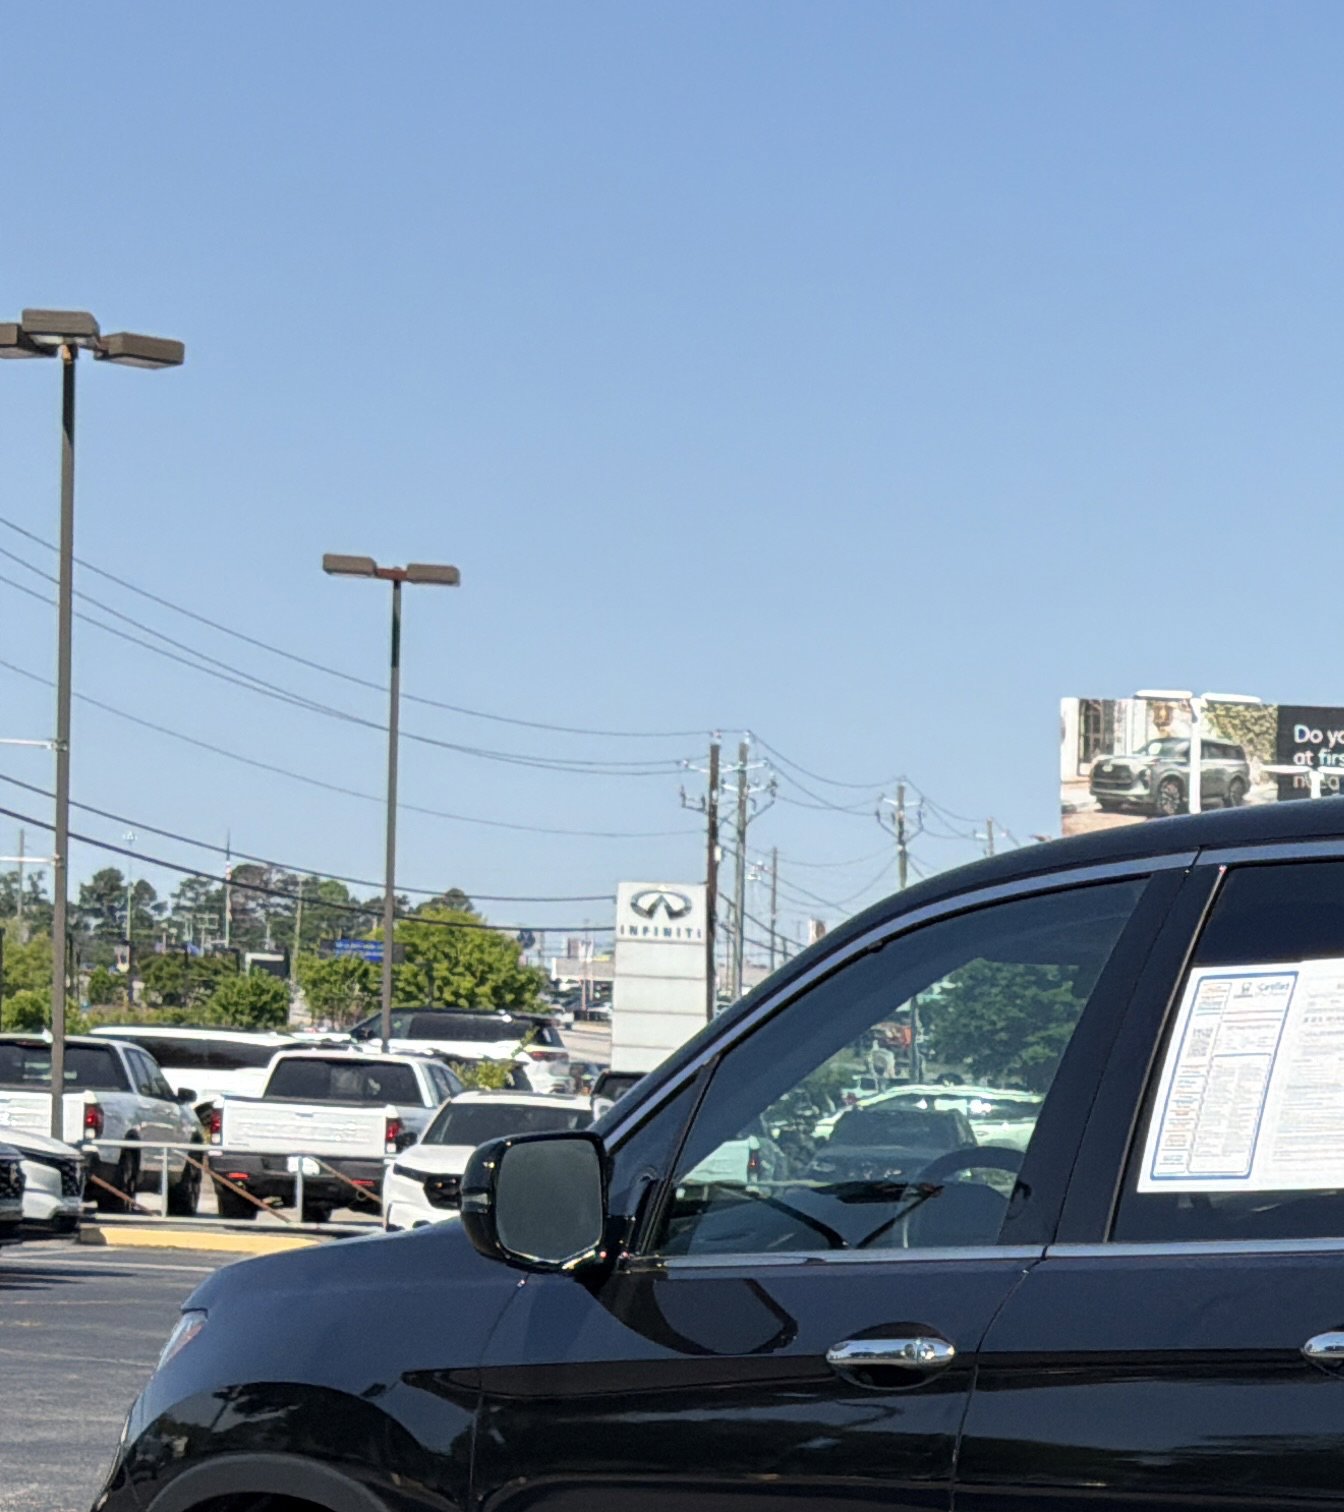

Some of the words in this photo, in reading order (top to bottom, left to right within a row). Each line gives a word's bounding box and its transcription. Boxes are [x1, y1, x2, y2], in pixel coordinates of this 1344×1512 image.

[1294, 725, 1323, 743] Do
[1293, 751, 1314, 766] at
[620, 925, 702, 938] INFINITI
